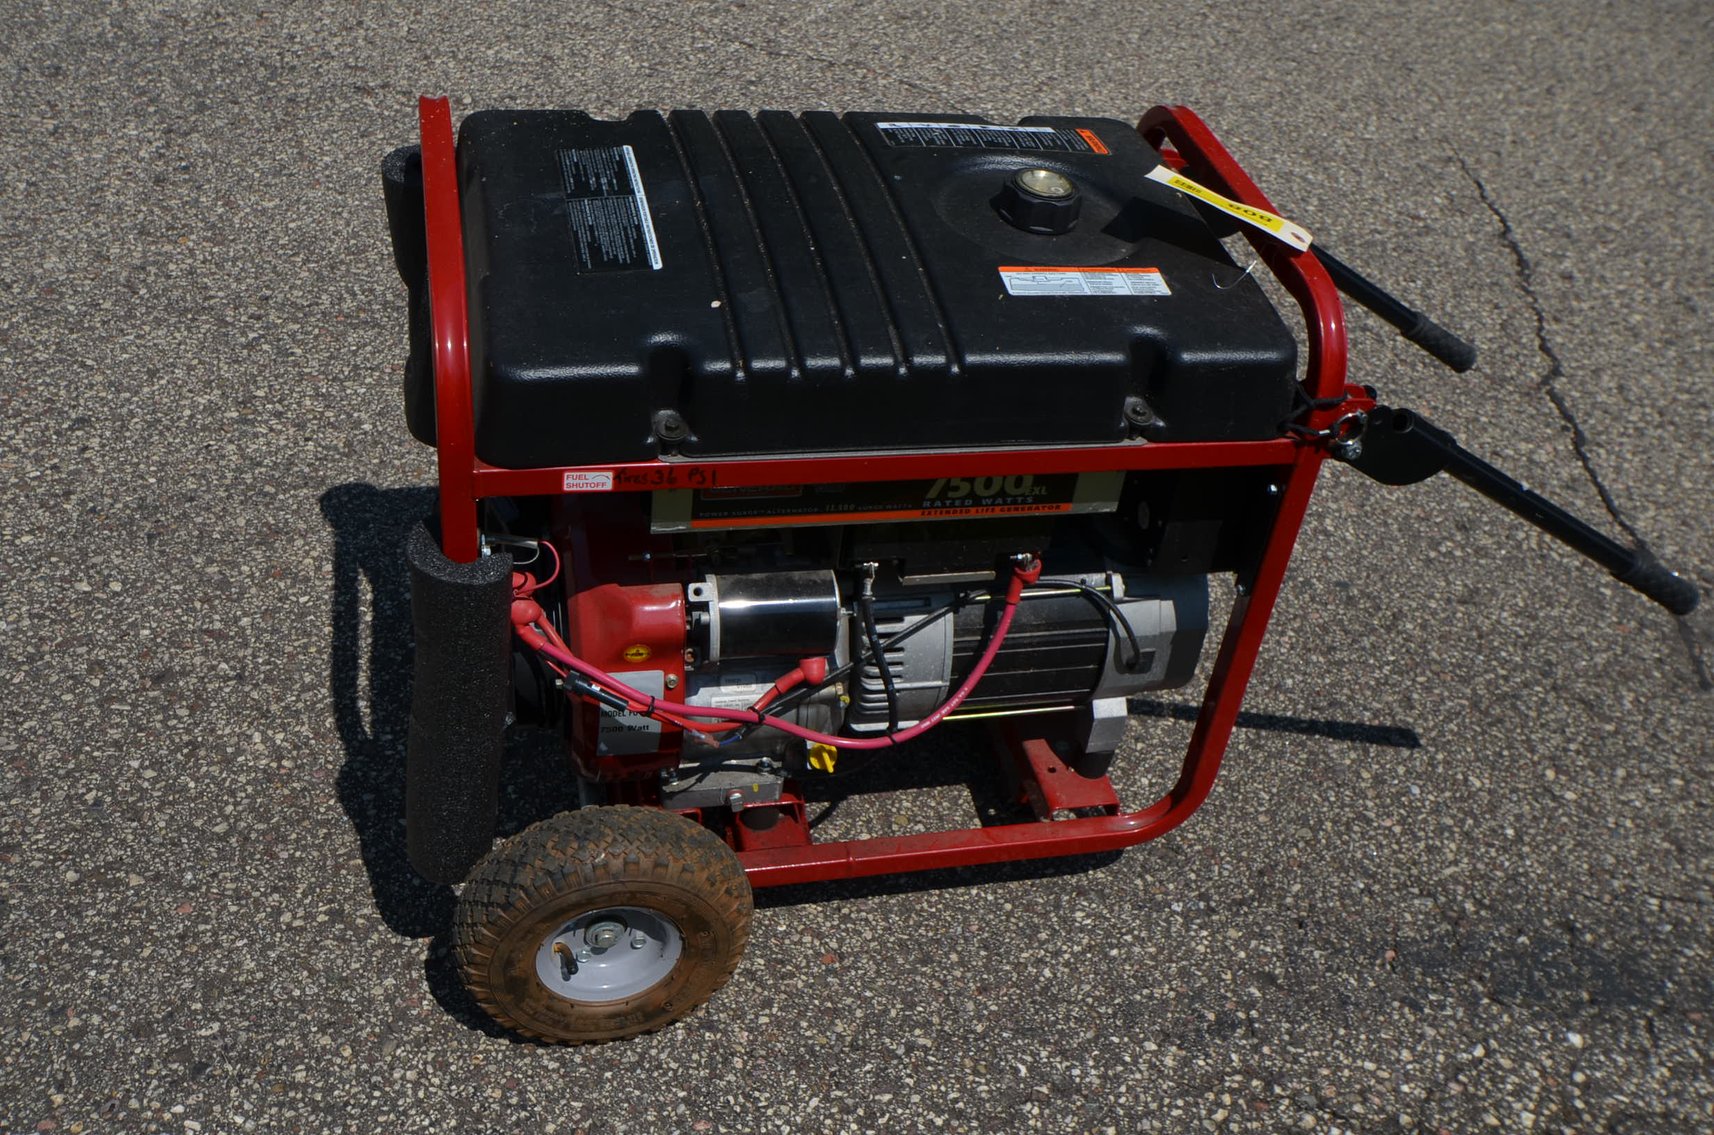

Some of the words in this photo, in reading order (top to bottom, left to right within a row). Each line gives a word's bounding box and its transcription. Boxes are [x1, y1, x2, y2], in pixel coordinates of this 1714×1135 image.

[922, 499, 973, 508] RATED
[982, 496, 1034, 505] WATTS
[1000, 504, 1062, 513] GENERATOR
[600, 710, 627, 718] MODEL
[627, 724, 650, 732] Watt
